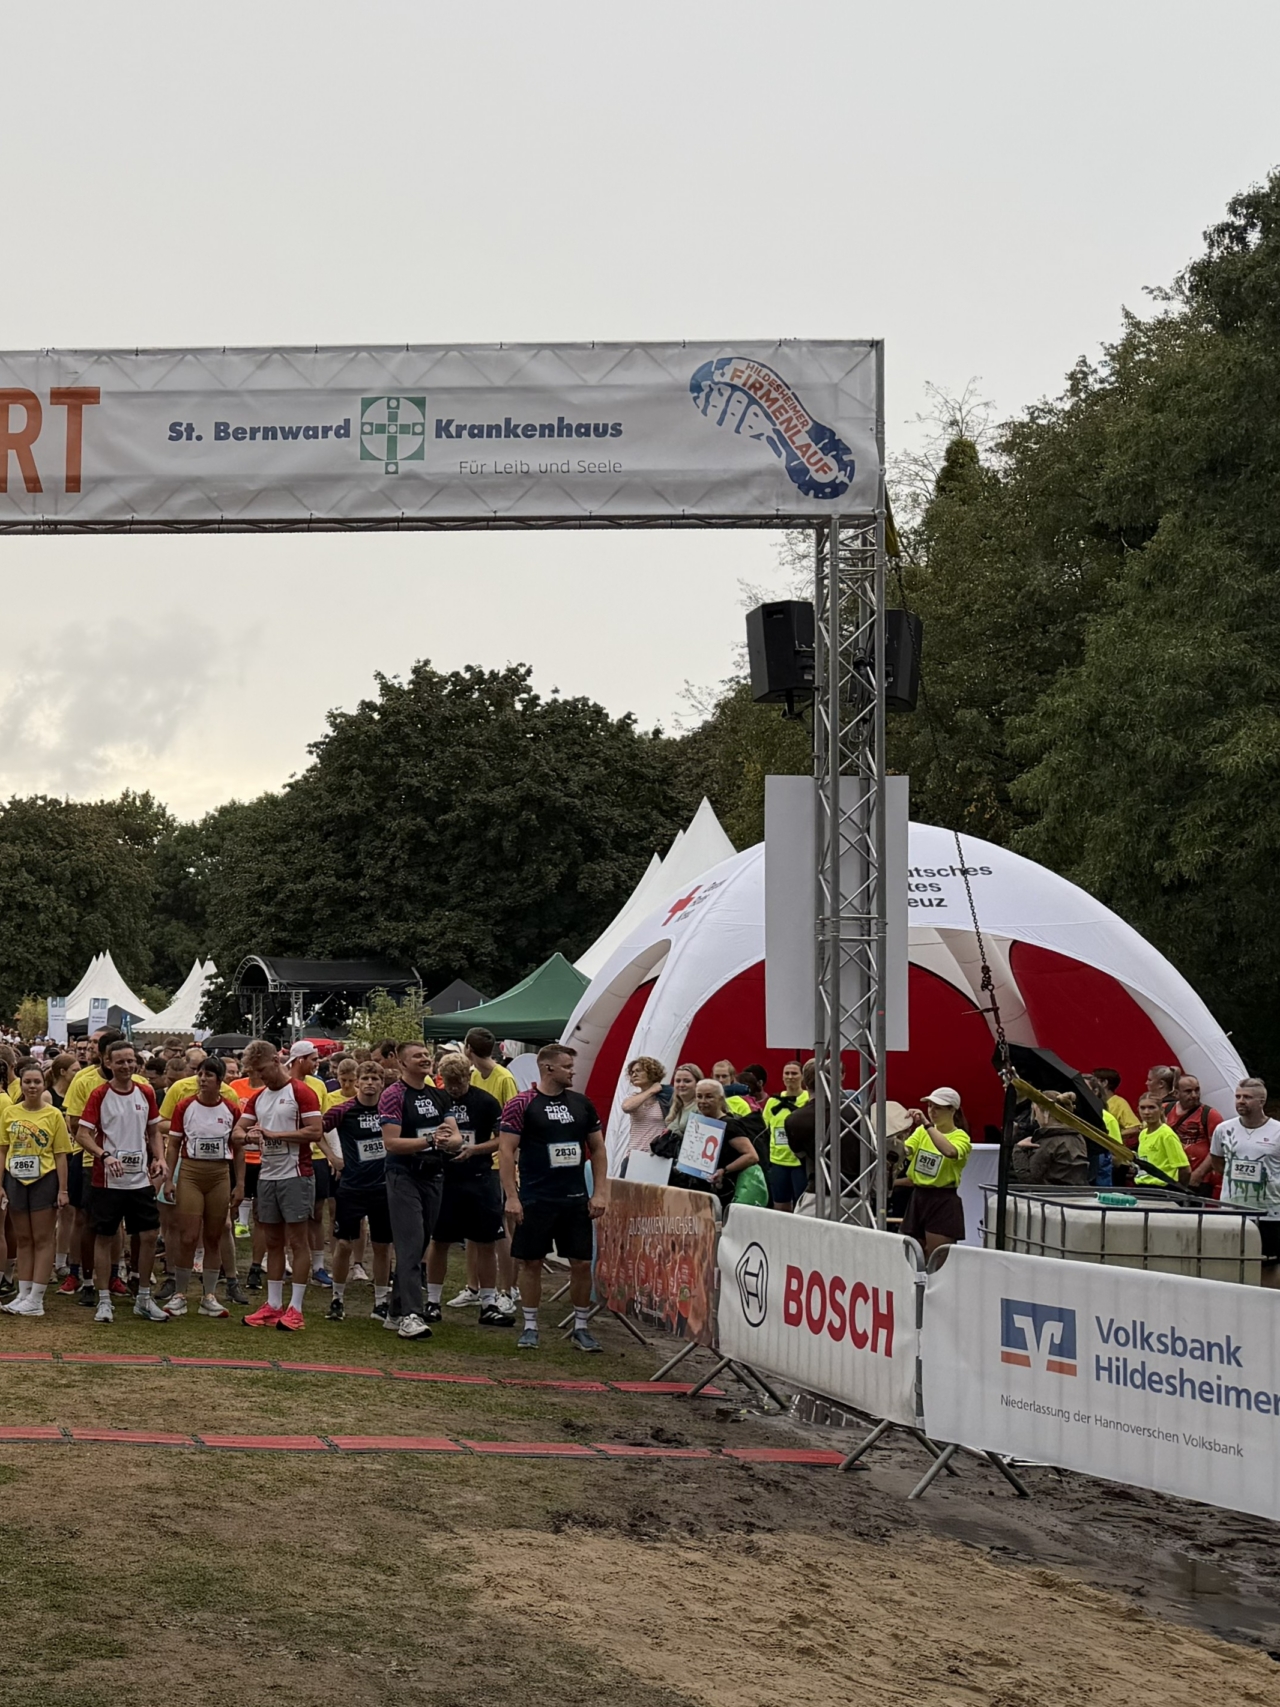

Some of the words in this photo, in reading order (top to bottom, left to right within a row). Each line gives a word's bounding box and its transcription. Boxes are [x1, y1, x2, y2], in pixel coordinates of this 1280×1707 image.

[745, 362, 809, 429] HILDESHEIMER
[168, 421, 203, 442] St.
[214, 418, 352, 442] Bernward
[435, 416, 624, 440] Krankenhaus
[729, 367, 833, 476] FIRMENLAUF
[459, 459, 487, 475] Für
[494, 459, 530, 475] Leib
[538, 459, 571, 475] und
[577, 458, 623, 475] Seele
[14, 1160, 35, 1169] 2862
[554, 1147, 577, 1157] 2830
[1234, 1163, 1256, 1174] 3273
[783, 1264, 895, 1359] BOSCH
[1094, 1315, 1244, 1368] Volksbank
[1094, 1354, 1280, 1417] Hildesheimer
[1000, 1393, 1070, 1423] Niederlassung
[1073, 1409, 1092, 1425] der
[1094, 1414, 1180, 1444] Hannoverschen
[1182, 1432, 1245, 1458] Volksbank
